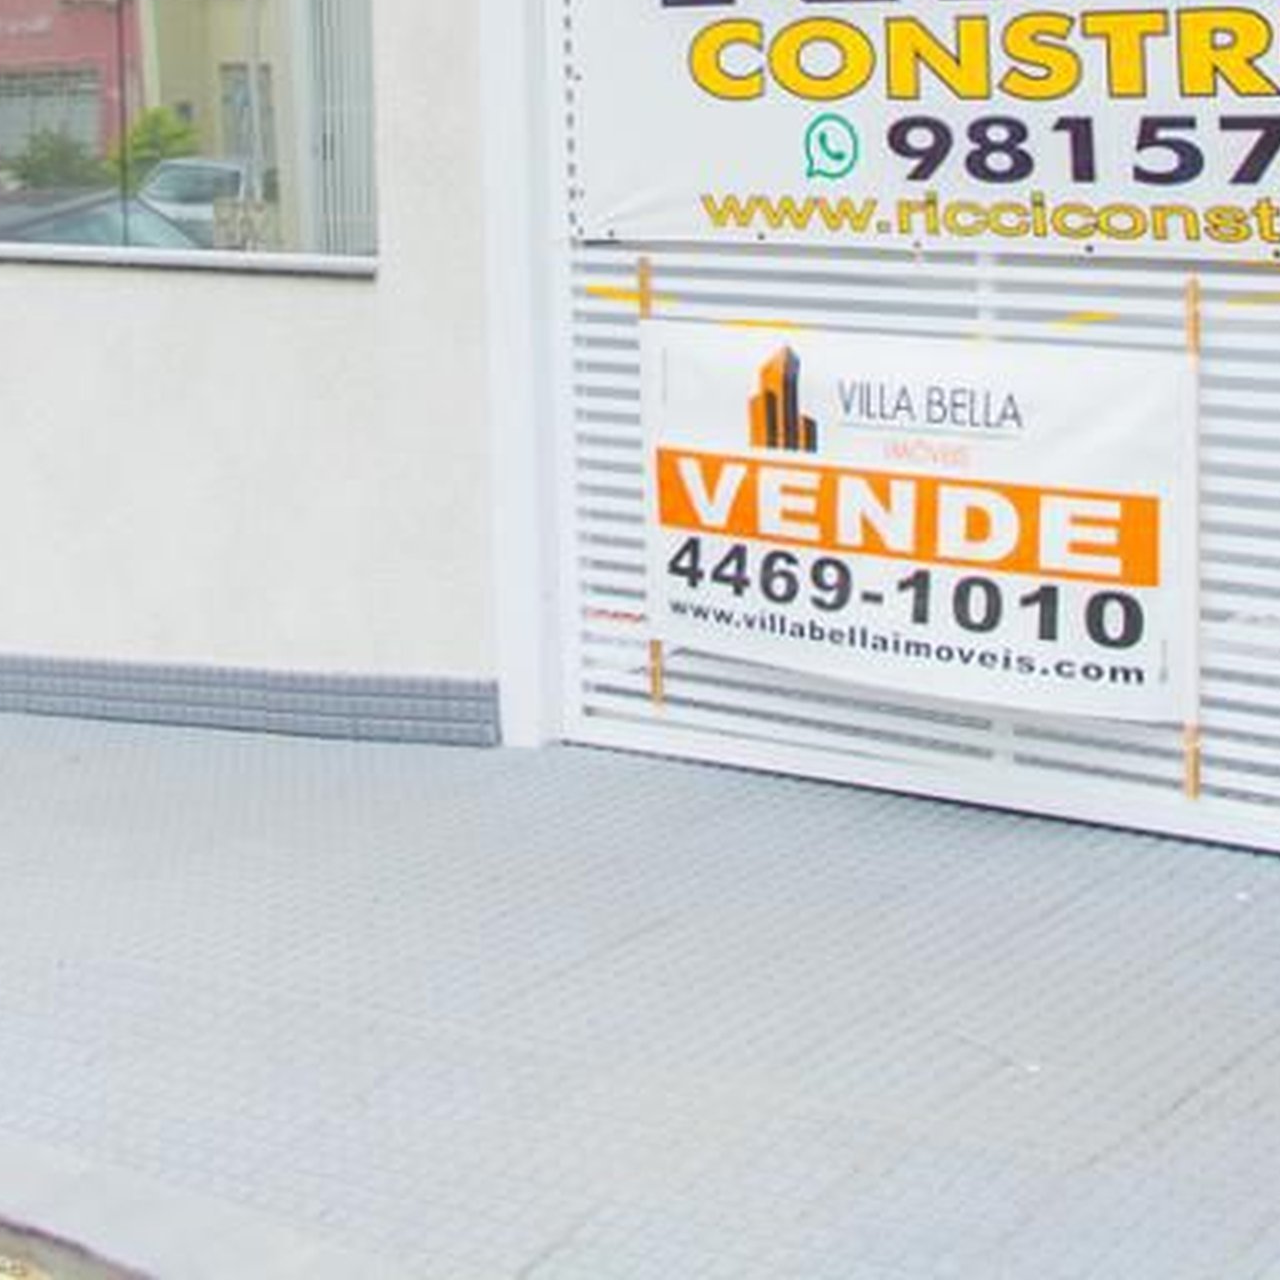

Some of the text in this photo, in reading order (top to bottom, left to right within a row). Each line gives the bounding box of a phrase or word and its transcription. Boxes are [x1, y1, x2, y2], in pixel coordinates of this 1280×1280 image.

[838, 379, 1024, 429] VILLA BELLA
[677, 457, 1121, 575] VENDE
[667, 536, 1145, 649] 4469-1010
[669, 598, 1146, 686] www.villabellaimoveis.com
